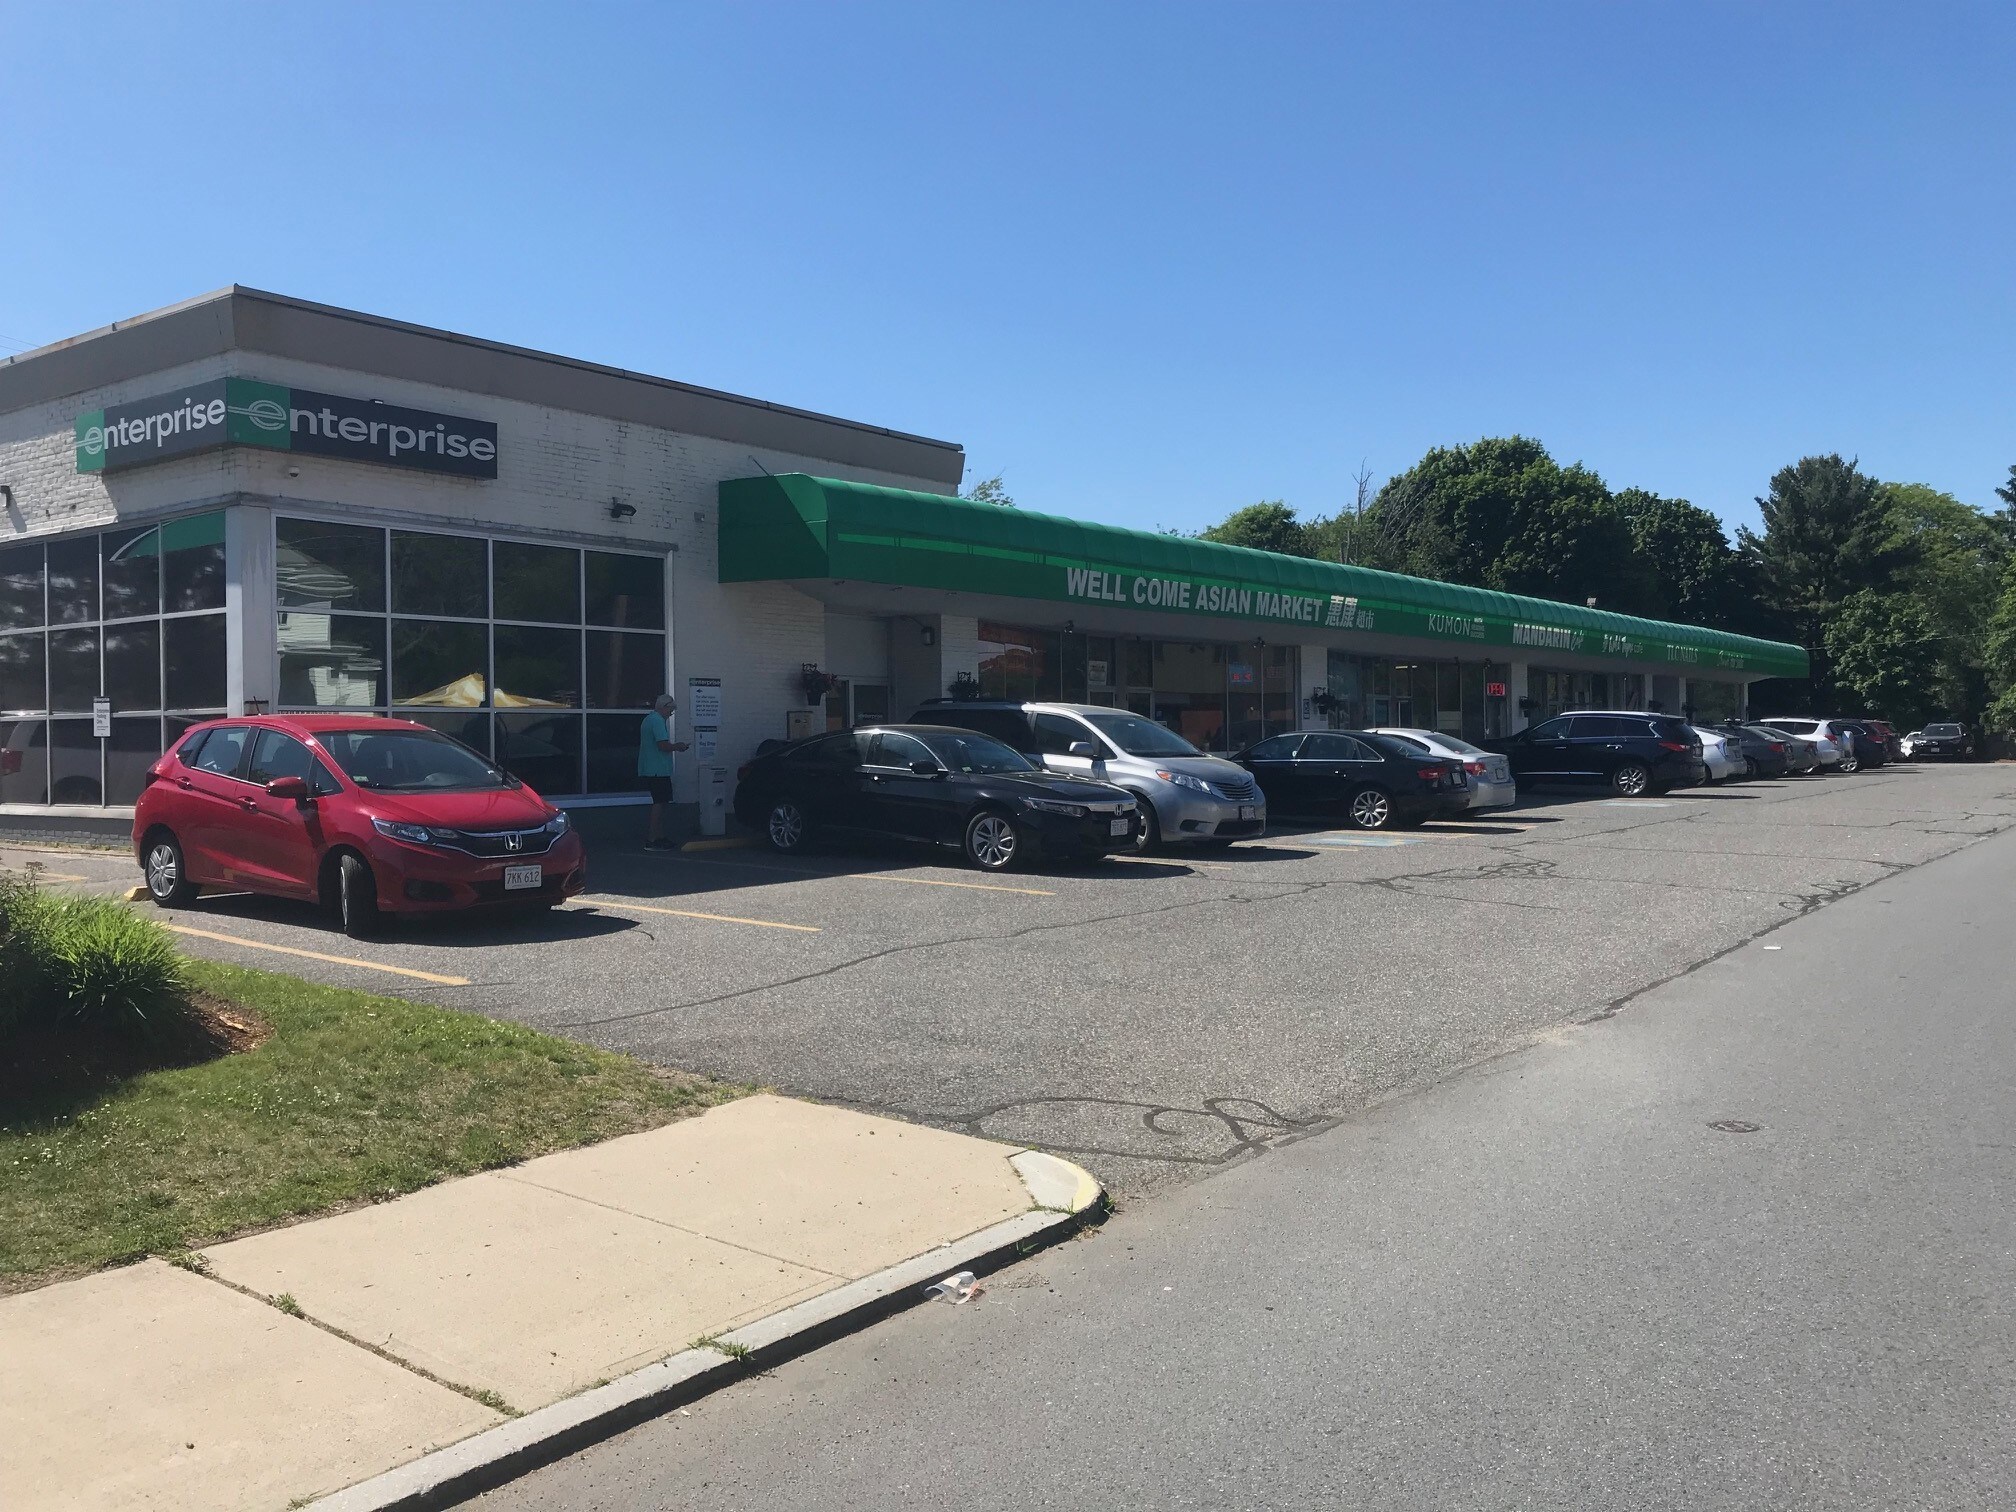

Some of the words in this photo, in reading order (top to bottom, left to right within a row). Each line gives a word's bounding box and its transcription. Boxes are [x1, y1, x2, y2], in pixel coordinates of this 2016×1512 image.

[82, 397, 227, 456] enterprise
[246, 398, 498, 463] enterprise
[1066, 567, 1127, 602] WELL
[1132, 576, 1191, 609] COME
[1196, 584, 1251, 615] ASIAN
[1255, 591, 1323, 623] MARKET
[1428, 613, 1472, 637] KUMON
[1512, 622, 1572, 650] MANDARIN
